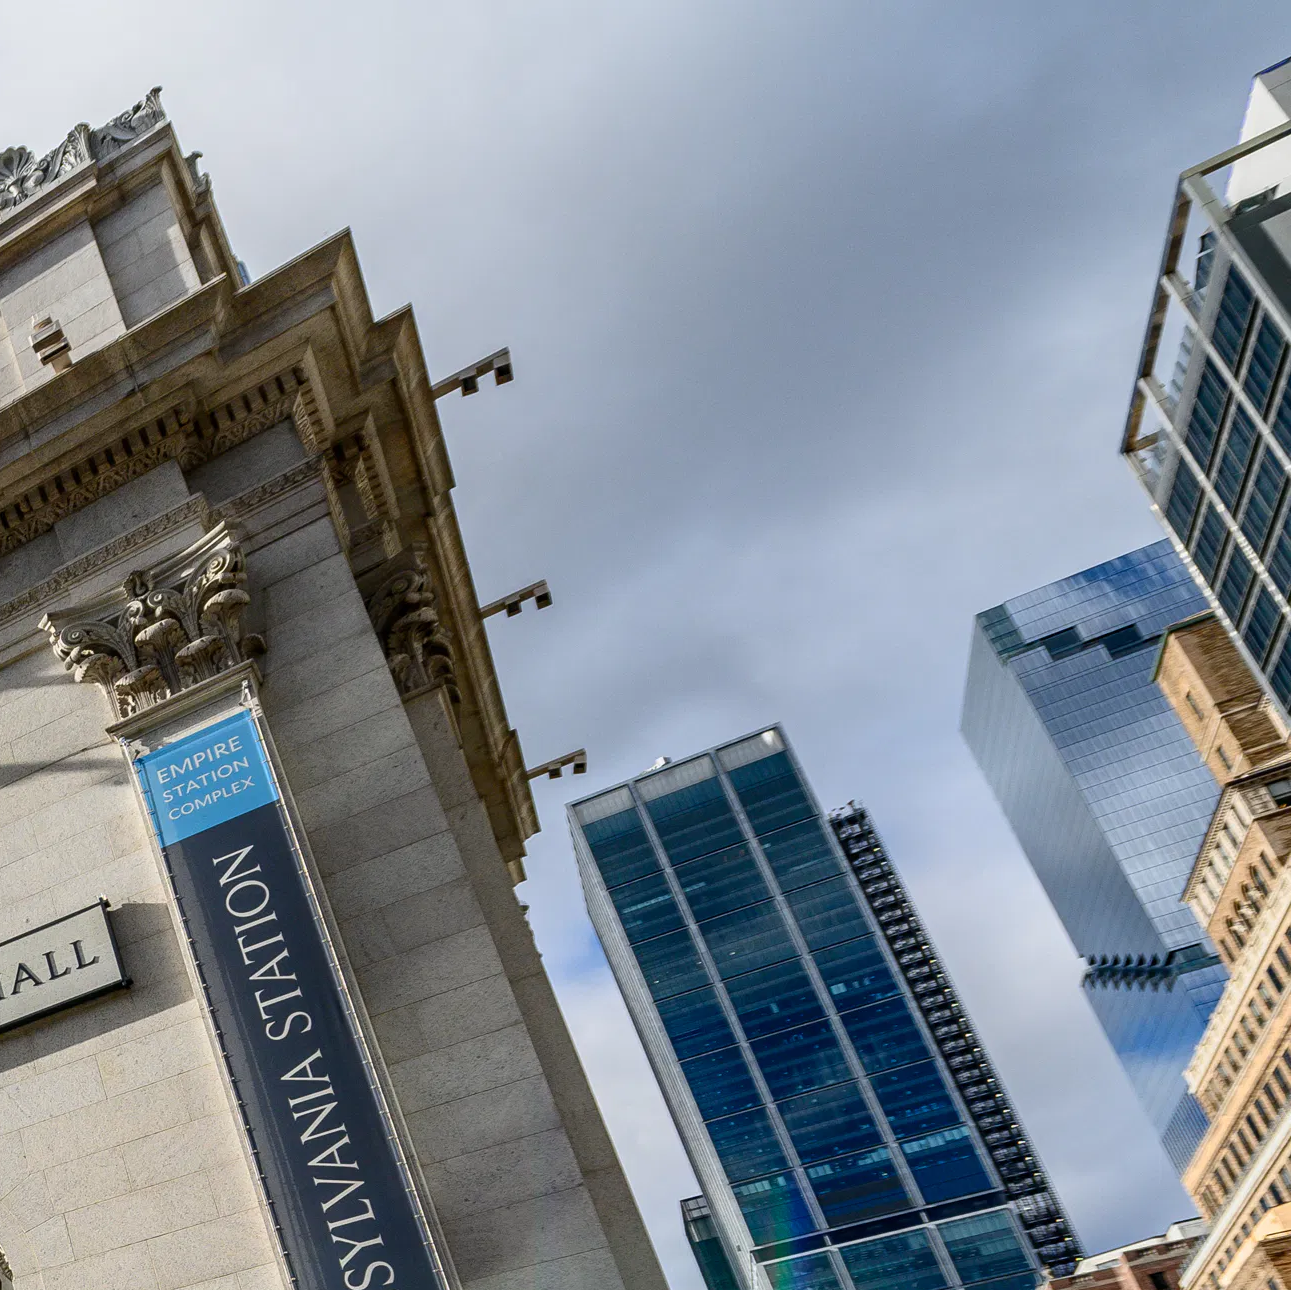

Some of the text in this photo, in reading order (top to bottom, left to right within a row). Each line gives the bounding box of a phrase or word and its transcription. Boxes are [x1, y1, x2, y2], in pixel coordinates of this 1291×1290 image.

[156, 735, 243, 785] EMPIRE
[162, 756, 250, 803] STATION
[168, 775, 255, 820] COMPLEX
[212, 844, 313, 1042] STATION
